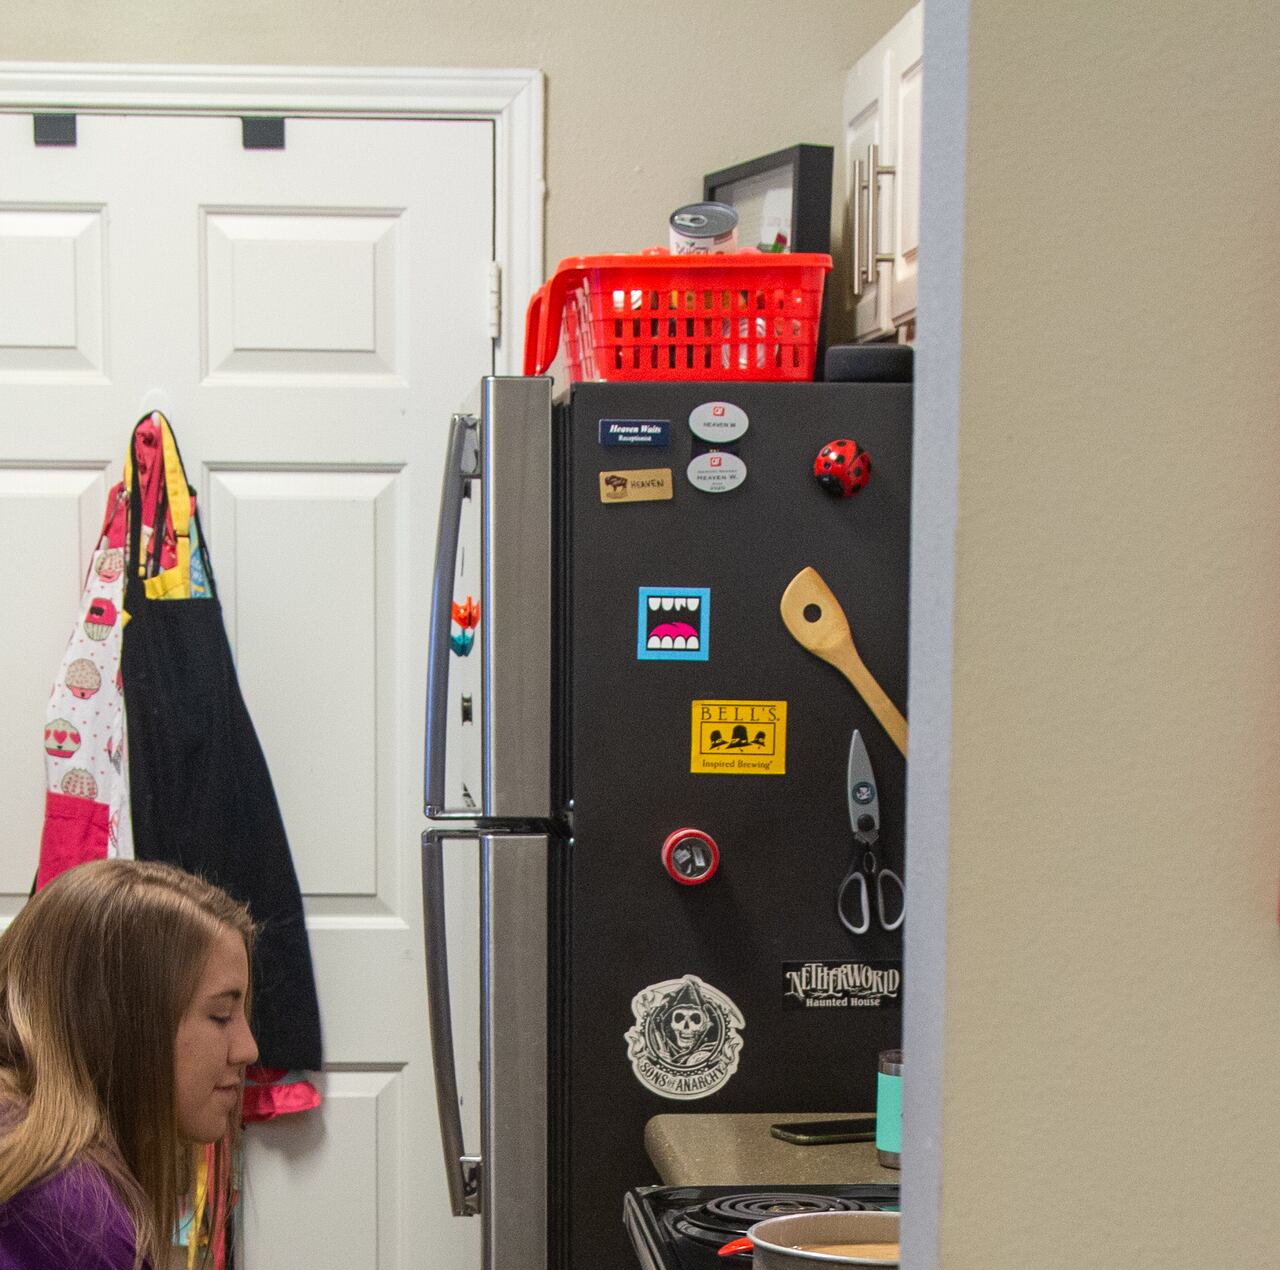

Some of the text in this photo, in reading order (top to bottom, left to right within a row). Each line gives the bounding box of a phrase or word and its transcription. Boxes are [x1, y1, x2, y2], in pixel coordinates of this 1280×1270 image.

[631, 479, 664, 488] HEAVEN
[702, 760, 736, 769] Inspired
[784, 963, 900, 998] NETHERWORLD
[806, 998, 881, 1007] Haunted House
[640, 1061, 668, 1088] SONS
[675, 1065, 725, 1092] ANARCHY
